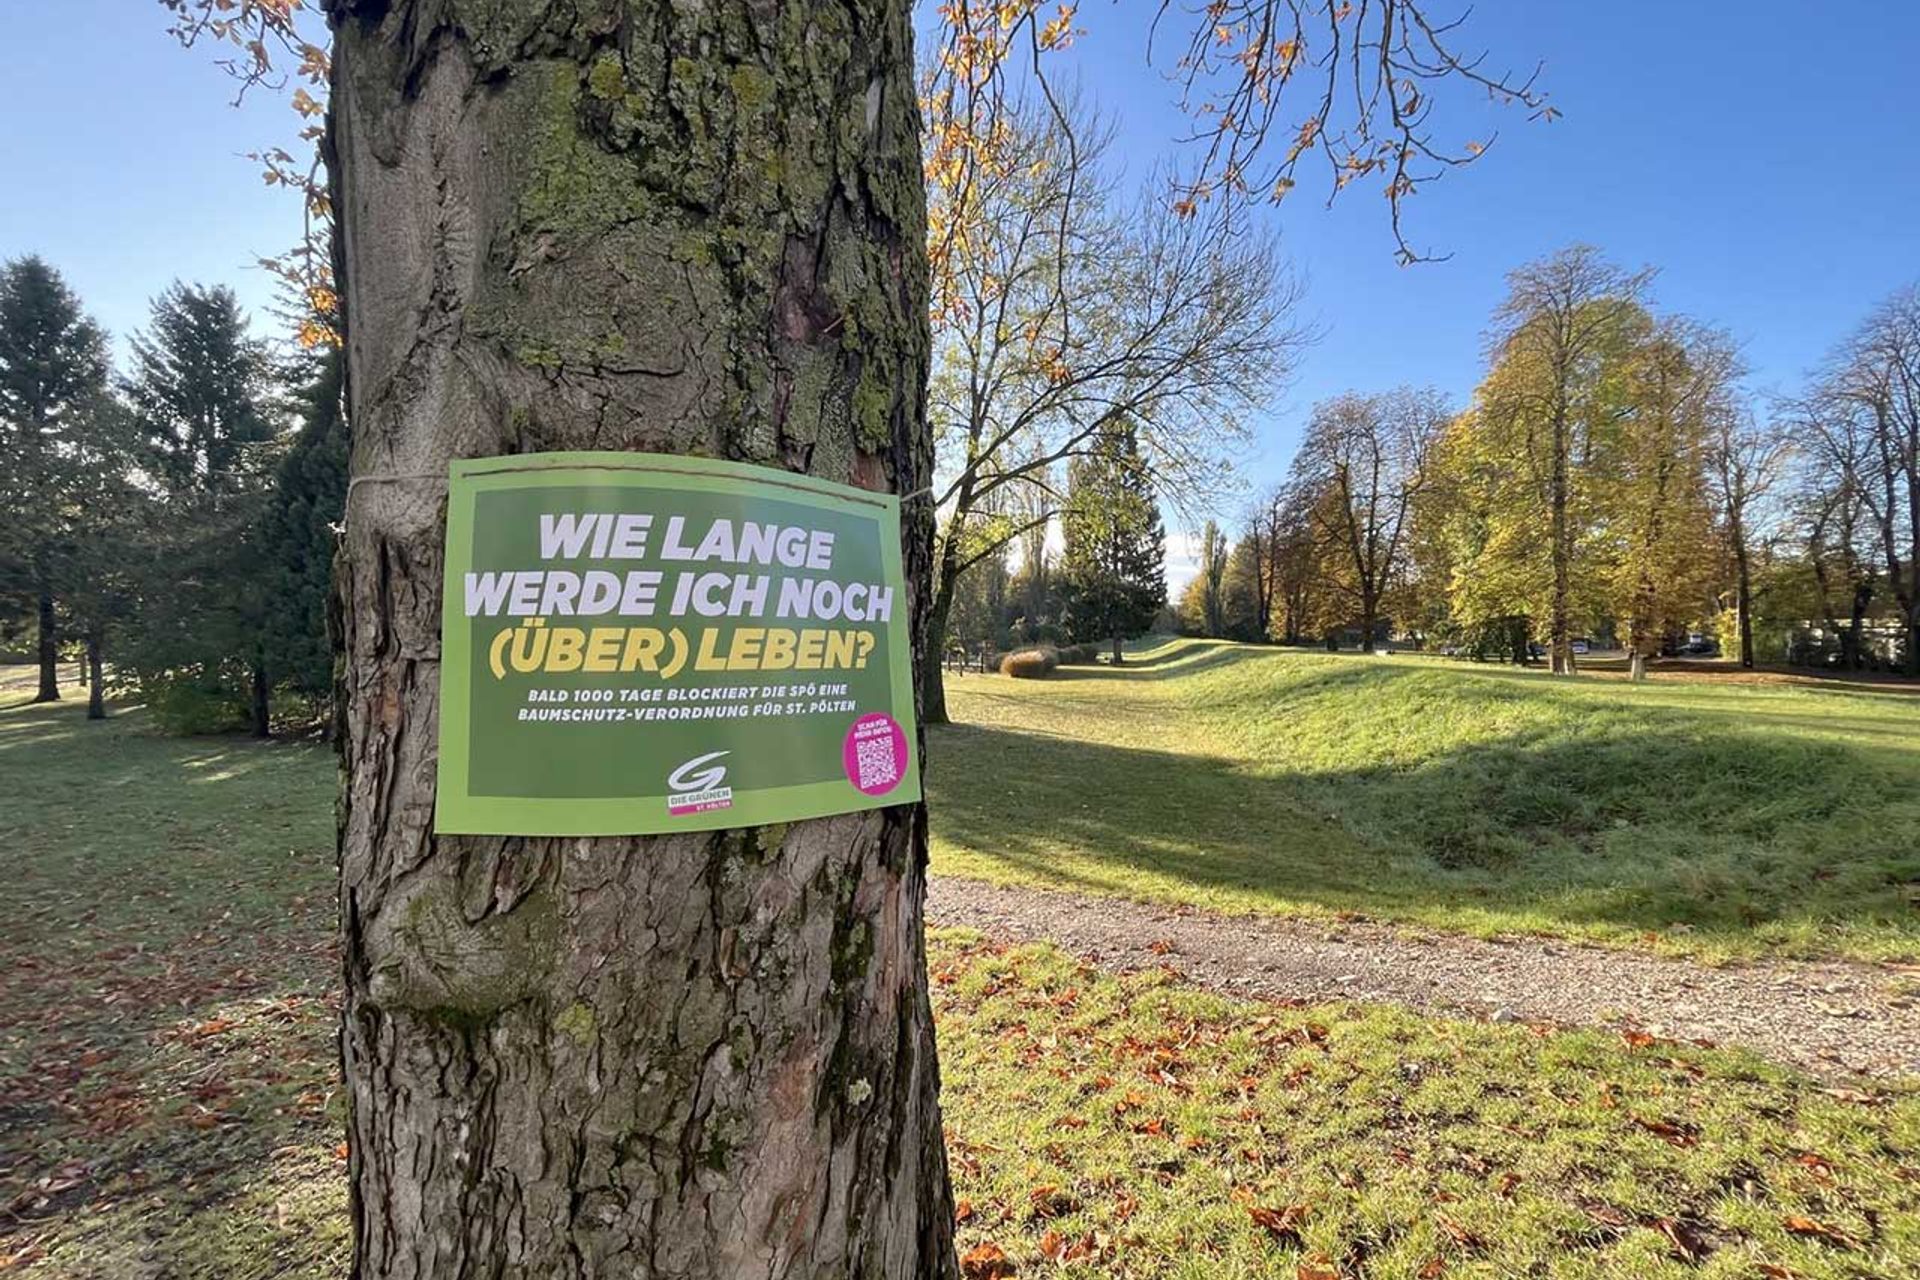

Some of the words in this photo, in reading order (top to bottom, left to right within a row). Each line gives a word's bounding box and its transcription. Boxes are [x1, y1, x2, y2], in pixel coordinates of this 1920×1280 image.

[539, 513, 654, 560] WIE
[660, 516, 835, 571] LANGE
[463, 571, 663, 617] WERDE
[669, 572, 771, 618] ICH
[776, 577, 895, 623] NOCH
[489, 617, 689, 680] (ÜBER)
[695, 627, 876, 671] LEBEN?
[518, 704, 748, 721] BAUMSCHUTZ-VERORDNUNG
[753, 701, 783, 716] FÜR
[786, 703, 806, 715] ST.
[809, 699, 856, 713] PÖLTEN
[528, 689, 569, 702] BALD
[573, 689, 614, 702] 1000
[619, 689, 663, 702] TAGE
[667, 687, 758, 701] BLOCKIERT
[761, 686, 787, 698] DIE
[789, 682, 816, 697] SPÖ
[819, 684, 848, 696] EINE
[670, 796, 687, 805] DIE
[688, 789, 729, 802] GRÜNEN
